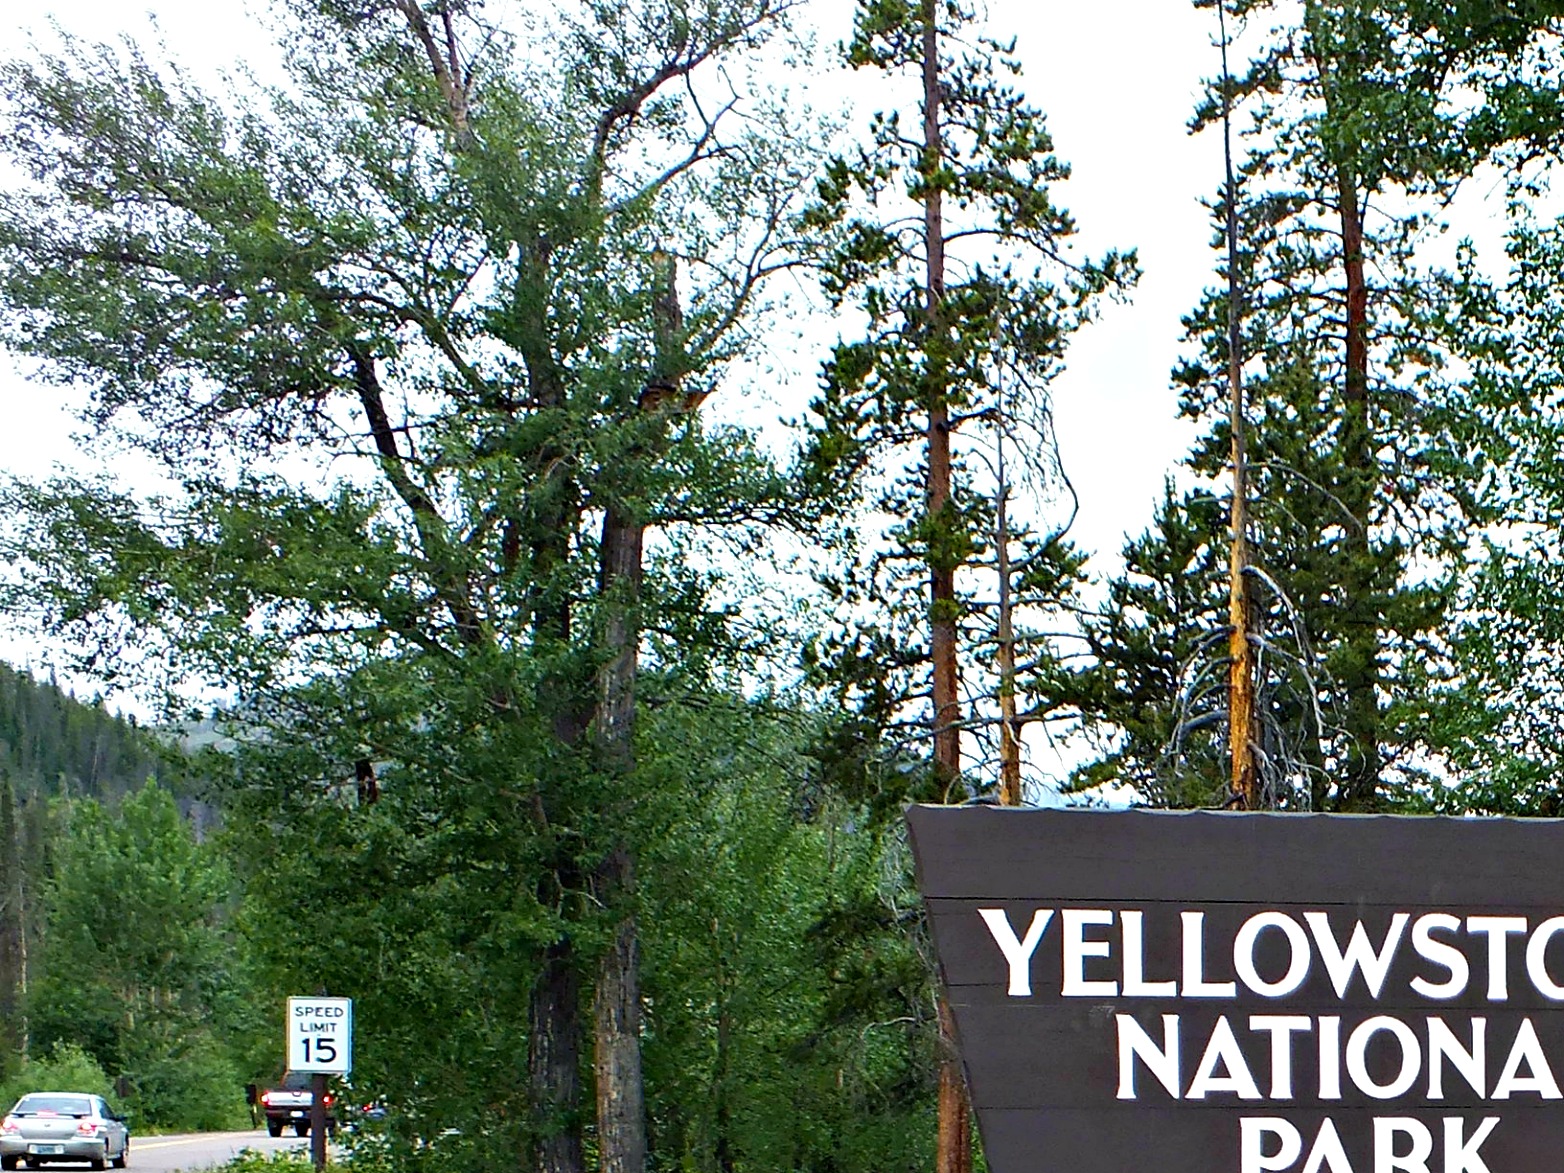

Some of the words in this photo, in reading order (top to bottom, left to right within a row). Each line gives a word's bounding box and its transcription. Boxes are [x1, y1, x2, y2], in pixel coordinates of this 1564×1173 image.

[295, 1006, 344, 1018] SPEED
[300, 1022, 337, 1033] LIMIT
[302, 1037, 337, 1064] 15
